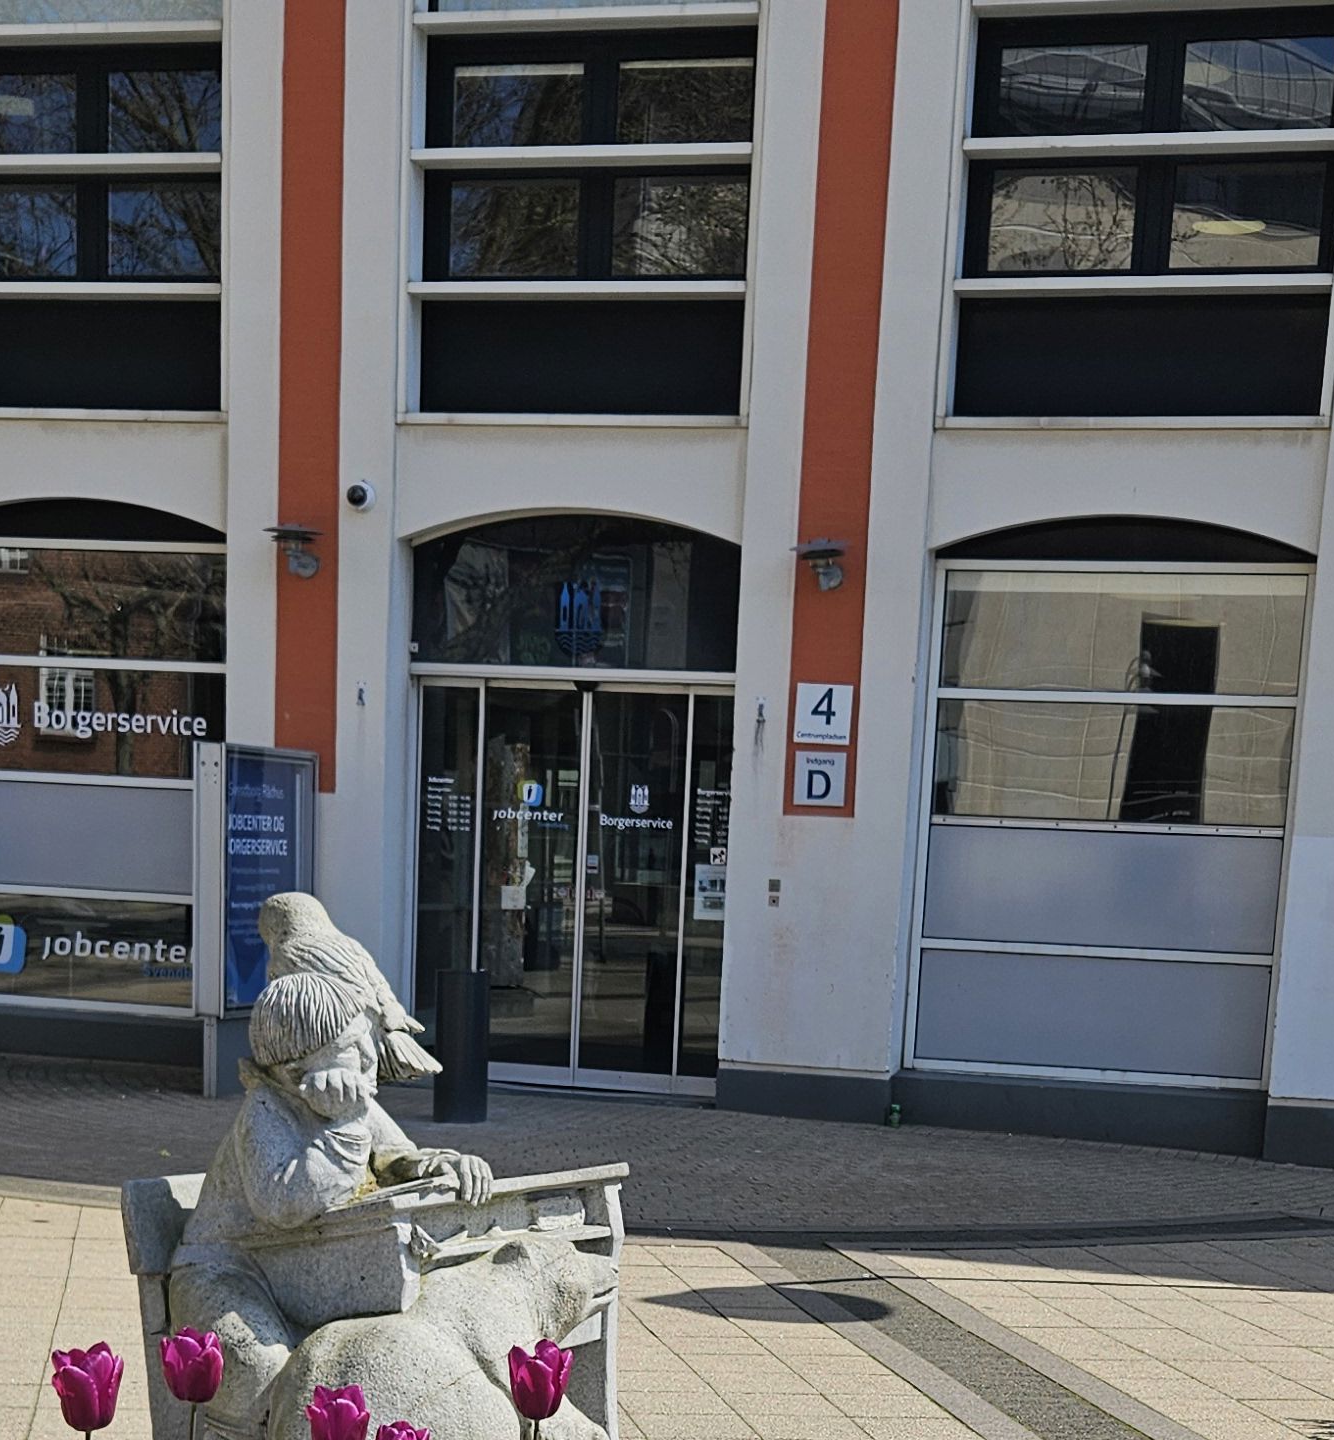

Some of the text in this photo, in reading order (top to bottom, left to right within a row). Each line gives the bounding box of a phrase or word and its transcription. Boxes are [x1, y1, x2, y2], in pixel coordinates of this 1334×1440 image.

[810, 687, 836, 725] 4
[34, 701, 208, 739] Borgerservice
[796, 731, 847, 741] Centrumpladsen
[806, 757, 835, 766] Indgang
[697, 788, 731, 798] Borgerserv
[807, 769, 831, 800] D
[228, 814, 285, 833] JOBCENTER OG
[492, 807, 564, 822] jobcenter
[599, 814, 673, 830] Borgerservice
[229, 838, 288, 857] ORGERSERVICE
[42, 931, 194, 964] jobcente
